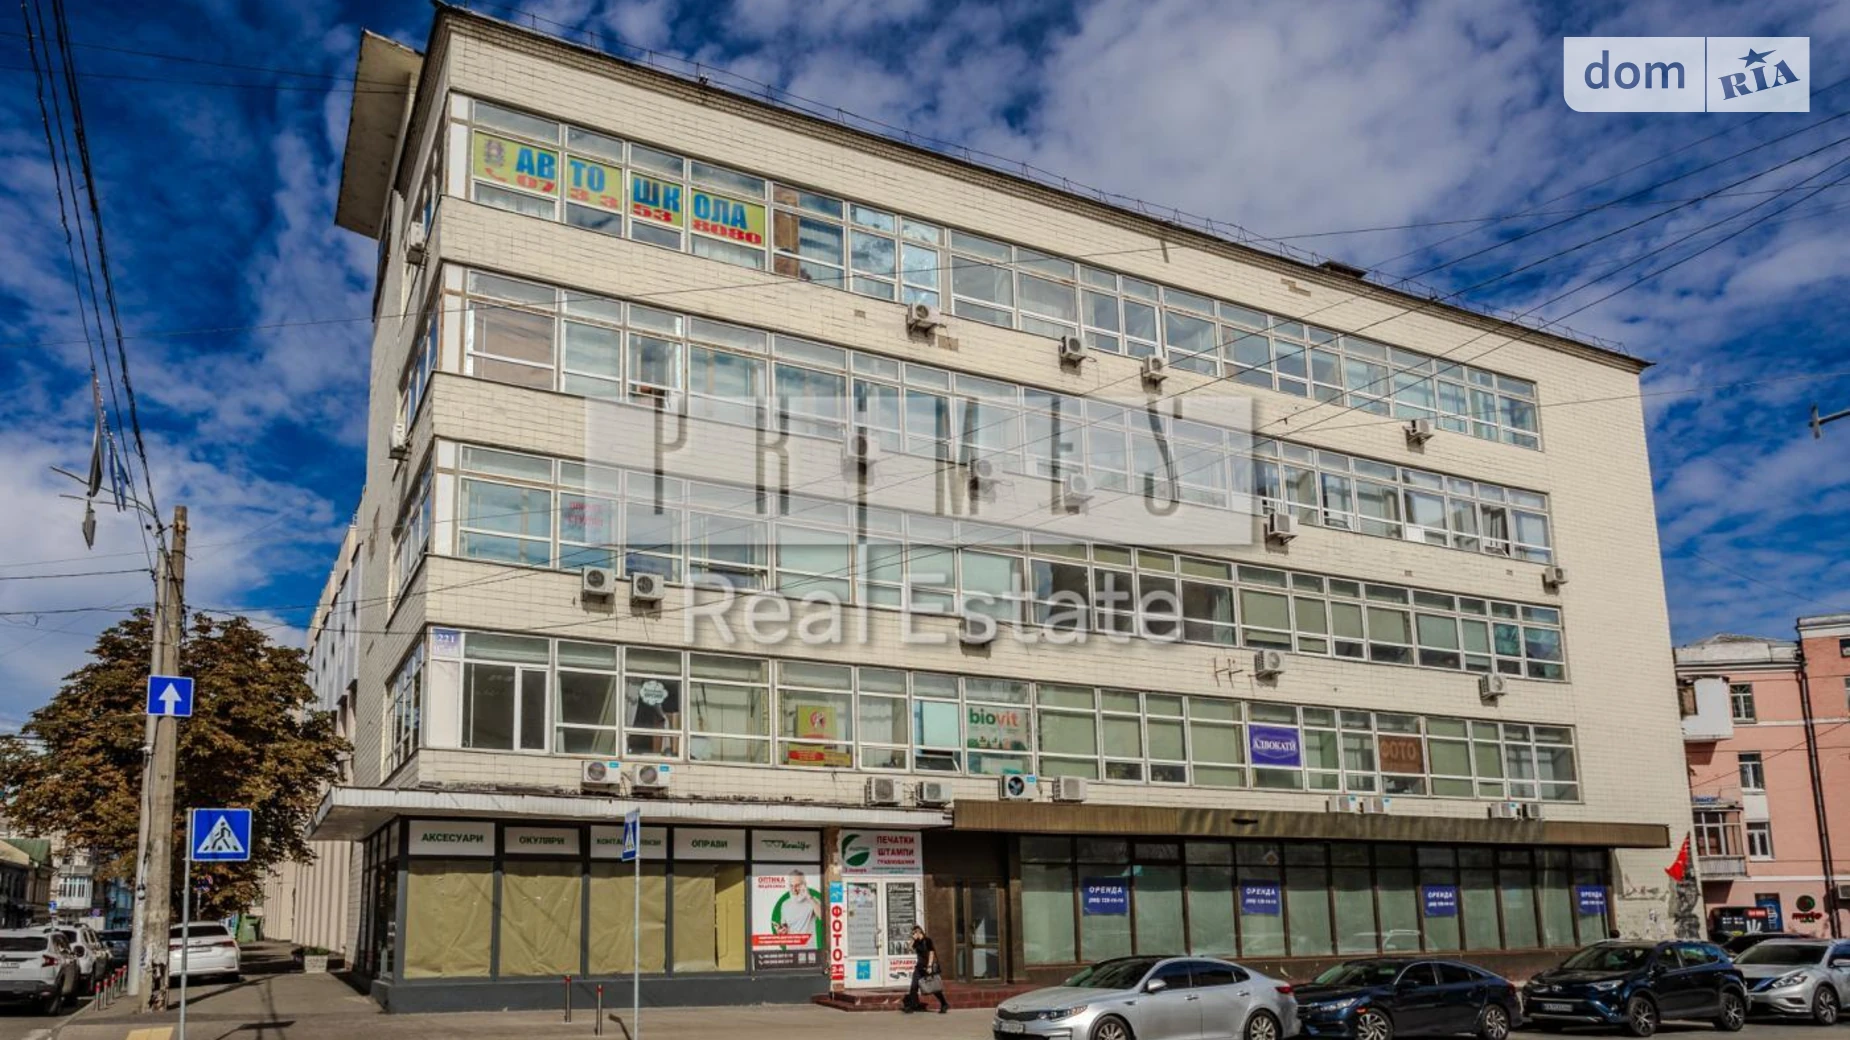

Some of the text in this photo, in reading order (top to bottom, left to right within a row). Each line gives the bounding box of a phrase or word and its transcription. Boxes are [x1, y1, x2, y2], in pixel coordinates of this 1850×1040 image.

[968, 707, 1018, 727] biovit
[421, 832, 484, 843] АКСЕСУАРИ
[519, 836, 565, 845] ОКУЛЯРИ
[876, 834, 915, 845] ПЕЧАТКИ
[691, 838, 728, 848] ОПРАВИ
[877, 847, 914, 857] ШТАМПИ
[757, 876, 786, 884] ОПТИКА
[1089, 885, 1123, 895] ОРЕНДА
[1245, 887, 1276, 897] ОРЕНДА
[831, 905, 843, 962] ФОТО
